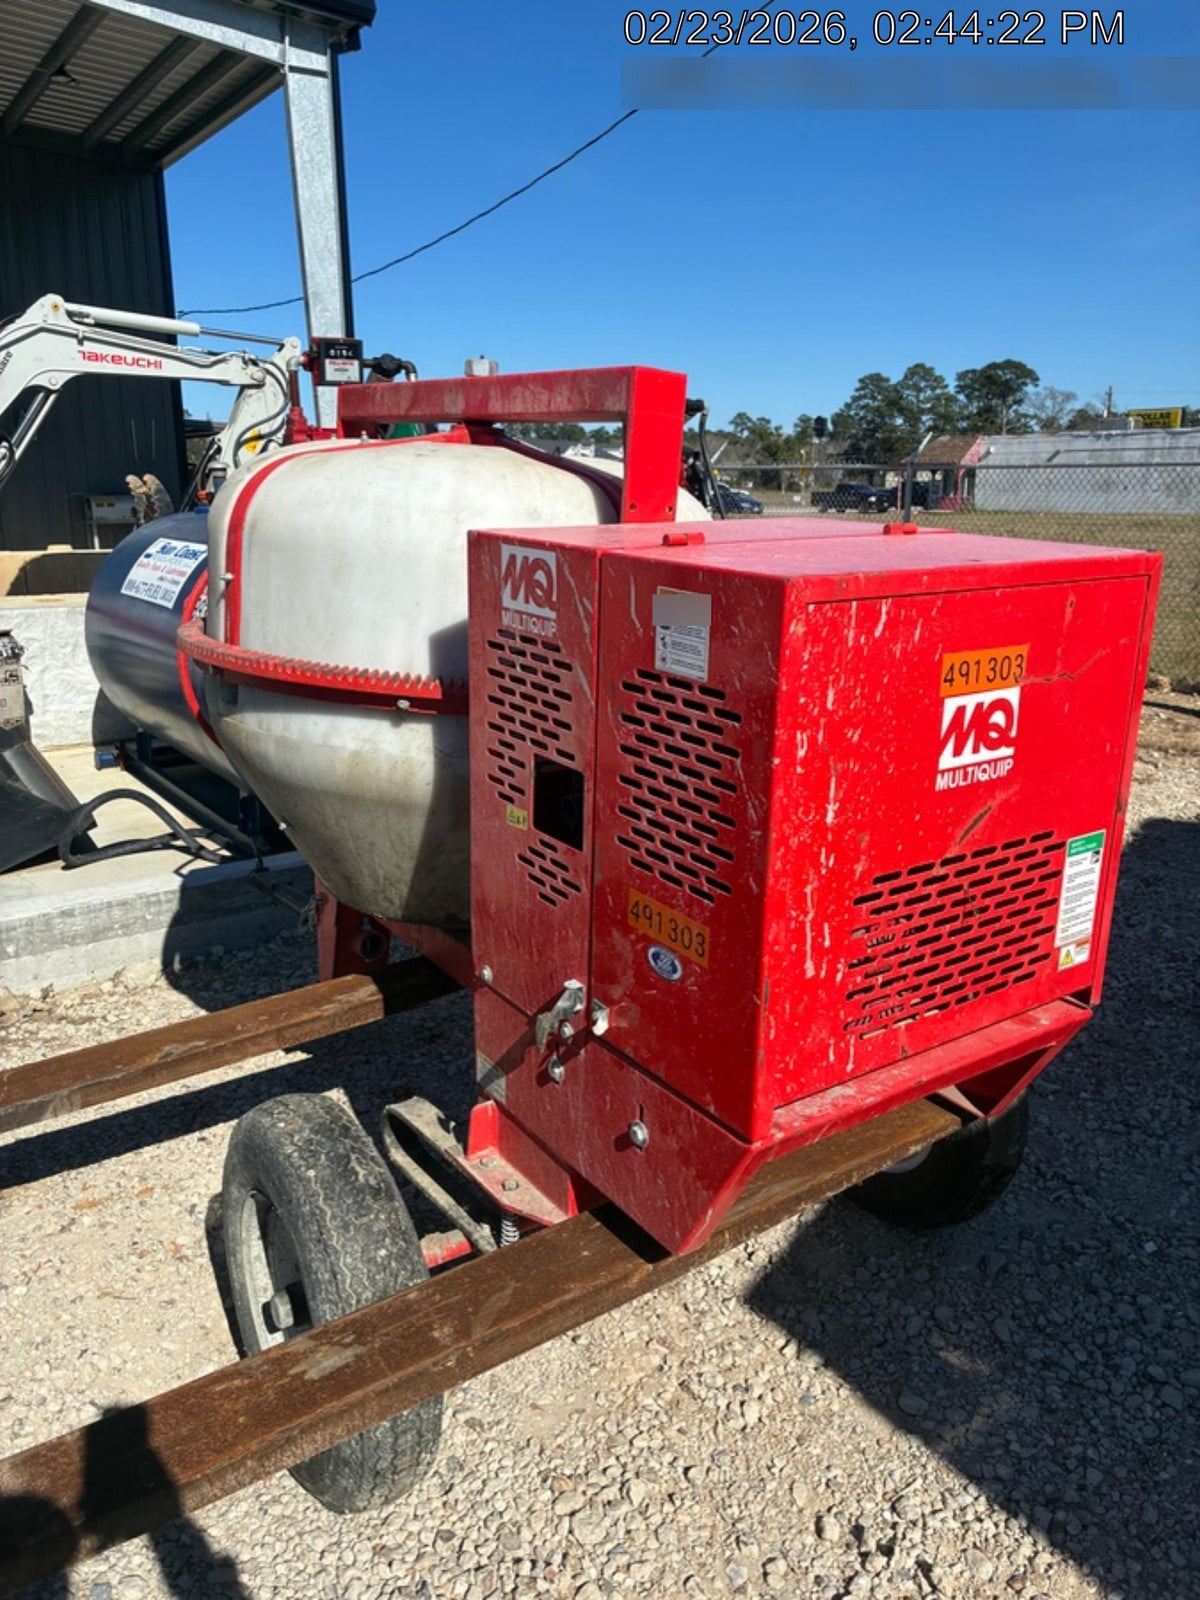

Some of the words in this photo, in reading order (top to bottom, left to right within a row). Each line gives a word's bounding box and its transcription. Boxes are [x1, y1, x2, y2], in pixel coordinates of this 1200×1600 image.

[502, 552, 558, 612] MQ
[501, 609, 557, 637] MULTIQUIP
[943, 654, 1025, 687] 491303
[940, 697, 1016, 758] MQ
[934, 758, 1014, 792] MULTIQUIP
[630, 900, 706, 958] 491303
